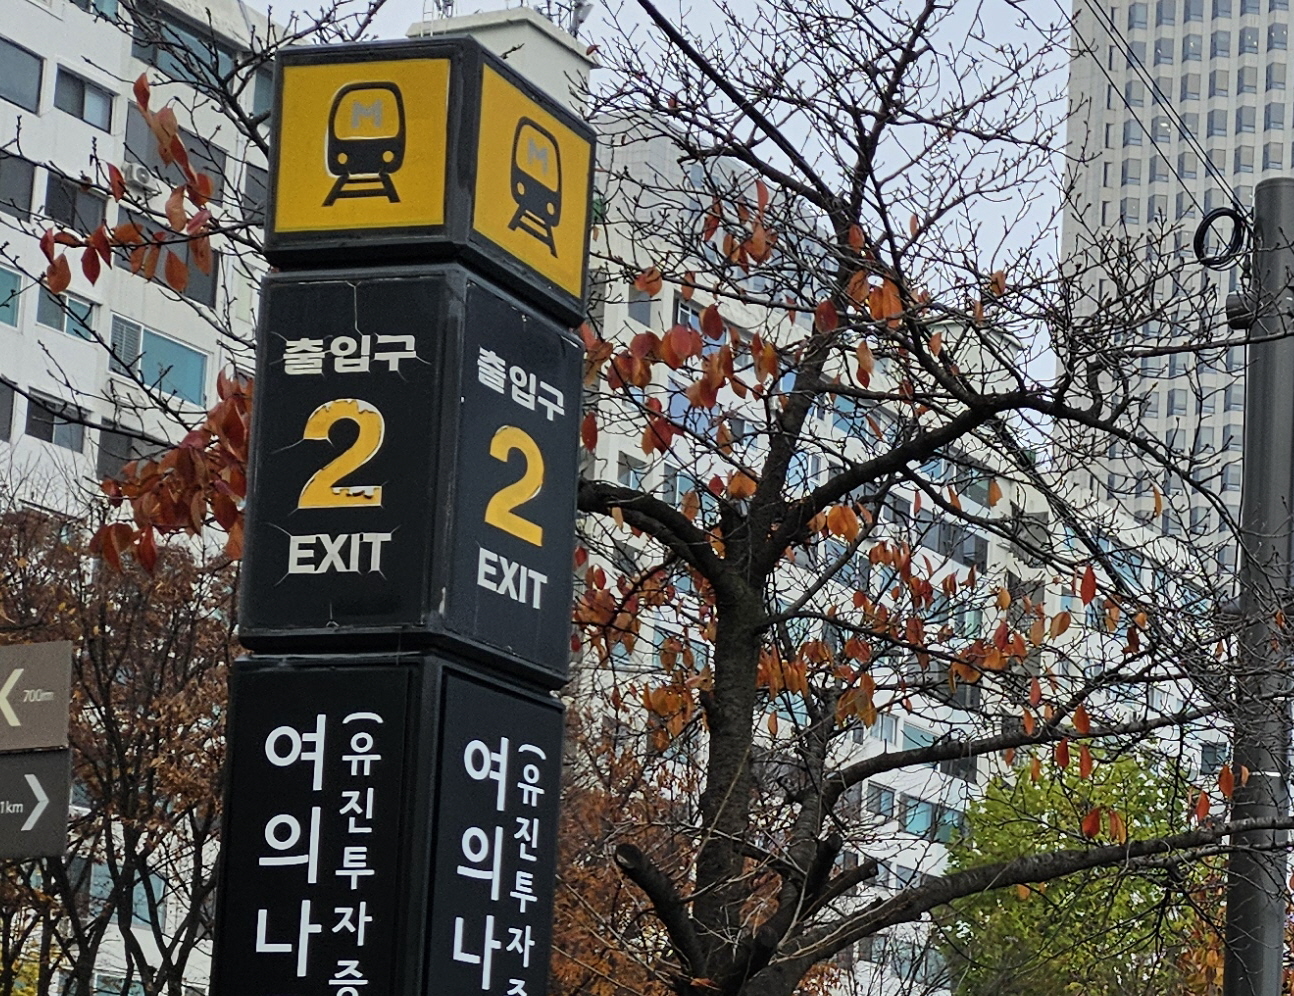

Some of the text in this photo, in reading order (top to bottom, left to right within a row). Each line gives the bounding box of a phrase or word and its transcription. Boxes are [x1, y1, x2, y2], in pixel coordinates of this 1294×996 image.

[282, 333, 417, 377] 출입구
[476, 345, 566, 421] 출입구
[298, 397, 385, 510] 2
[483, 423, 546, 547] 2
[286, 532, 393, 575] EXIT
[476, 548, 548, 610] EXIT
